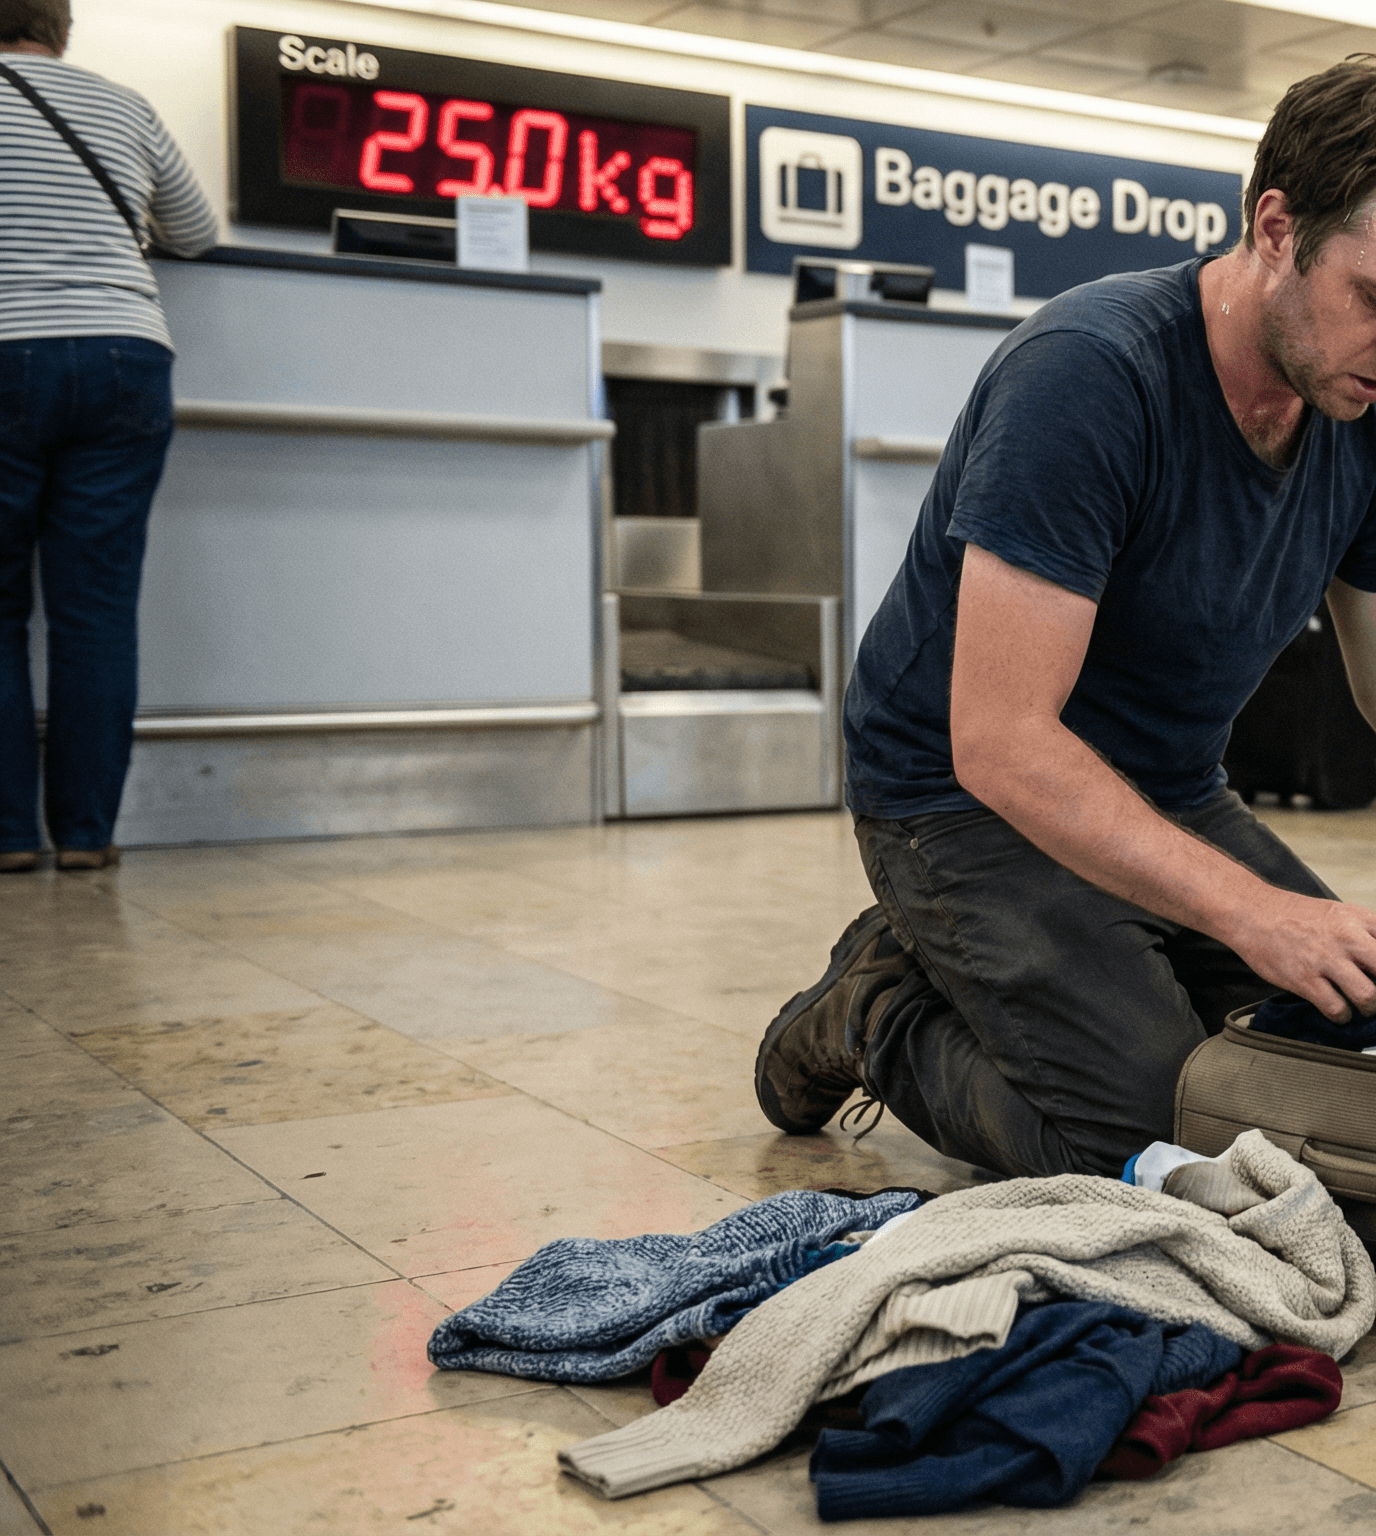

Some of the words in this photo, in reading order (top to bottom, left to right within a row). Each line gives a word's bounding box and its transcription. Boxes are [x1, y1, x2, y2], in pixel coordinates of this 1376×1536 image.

[278, 35, 380, 80] Scale
[874, 146, 1102, 238] Baggage
[1111, 177, 1229, 253] Drop
